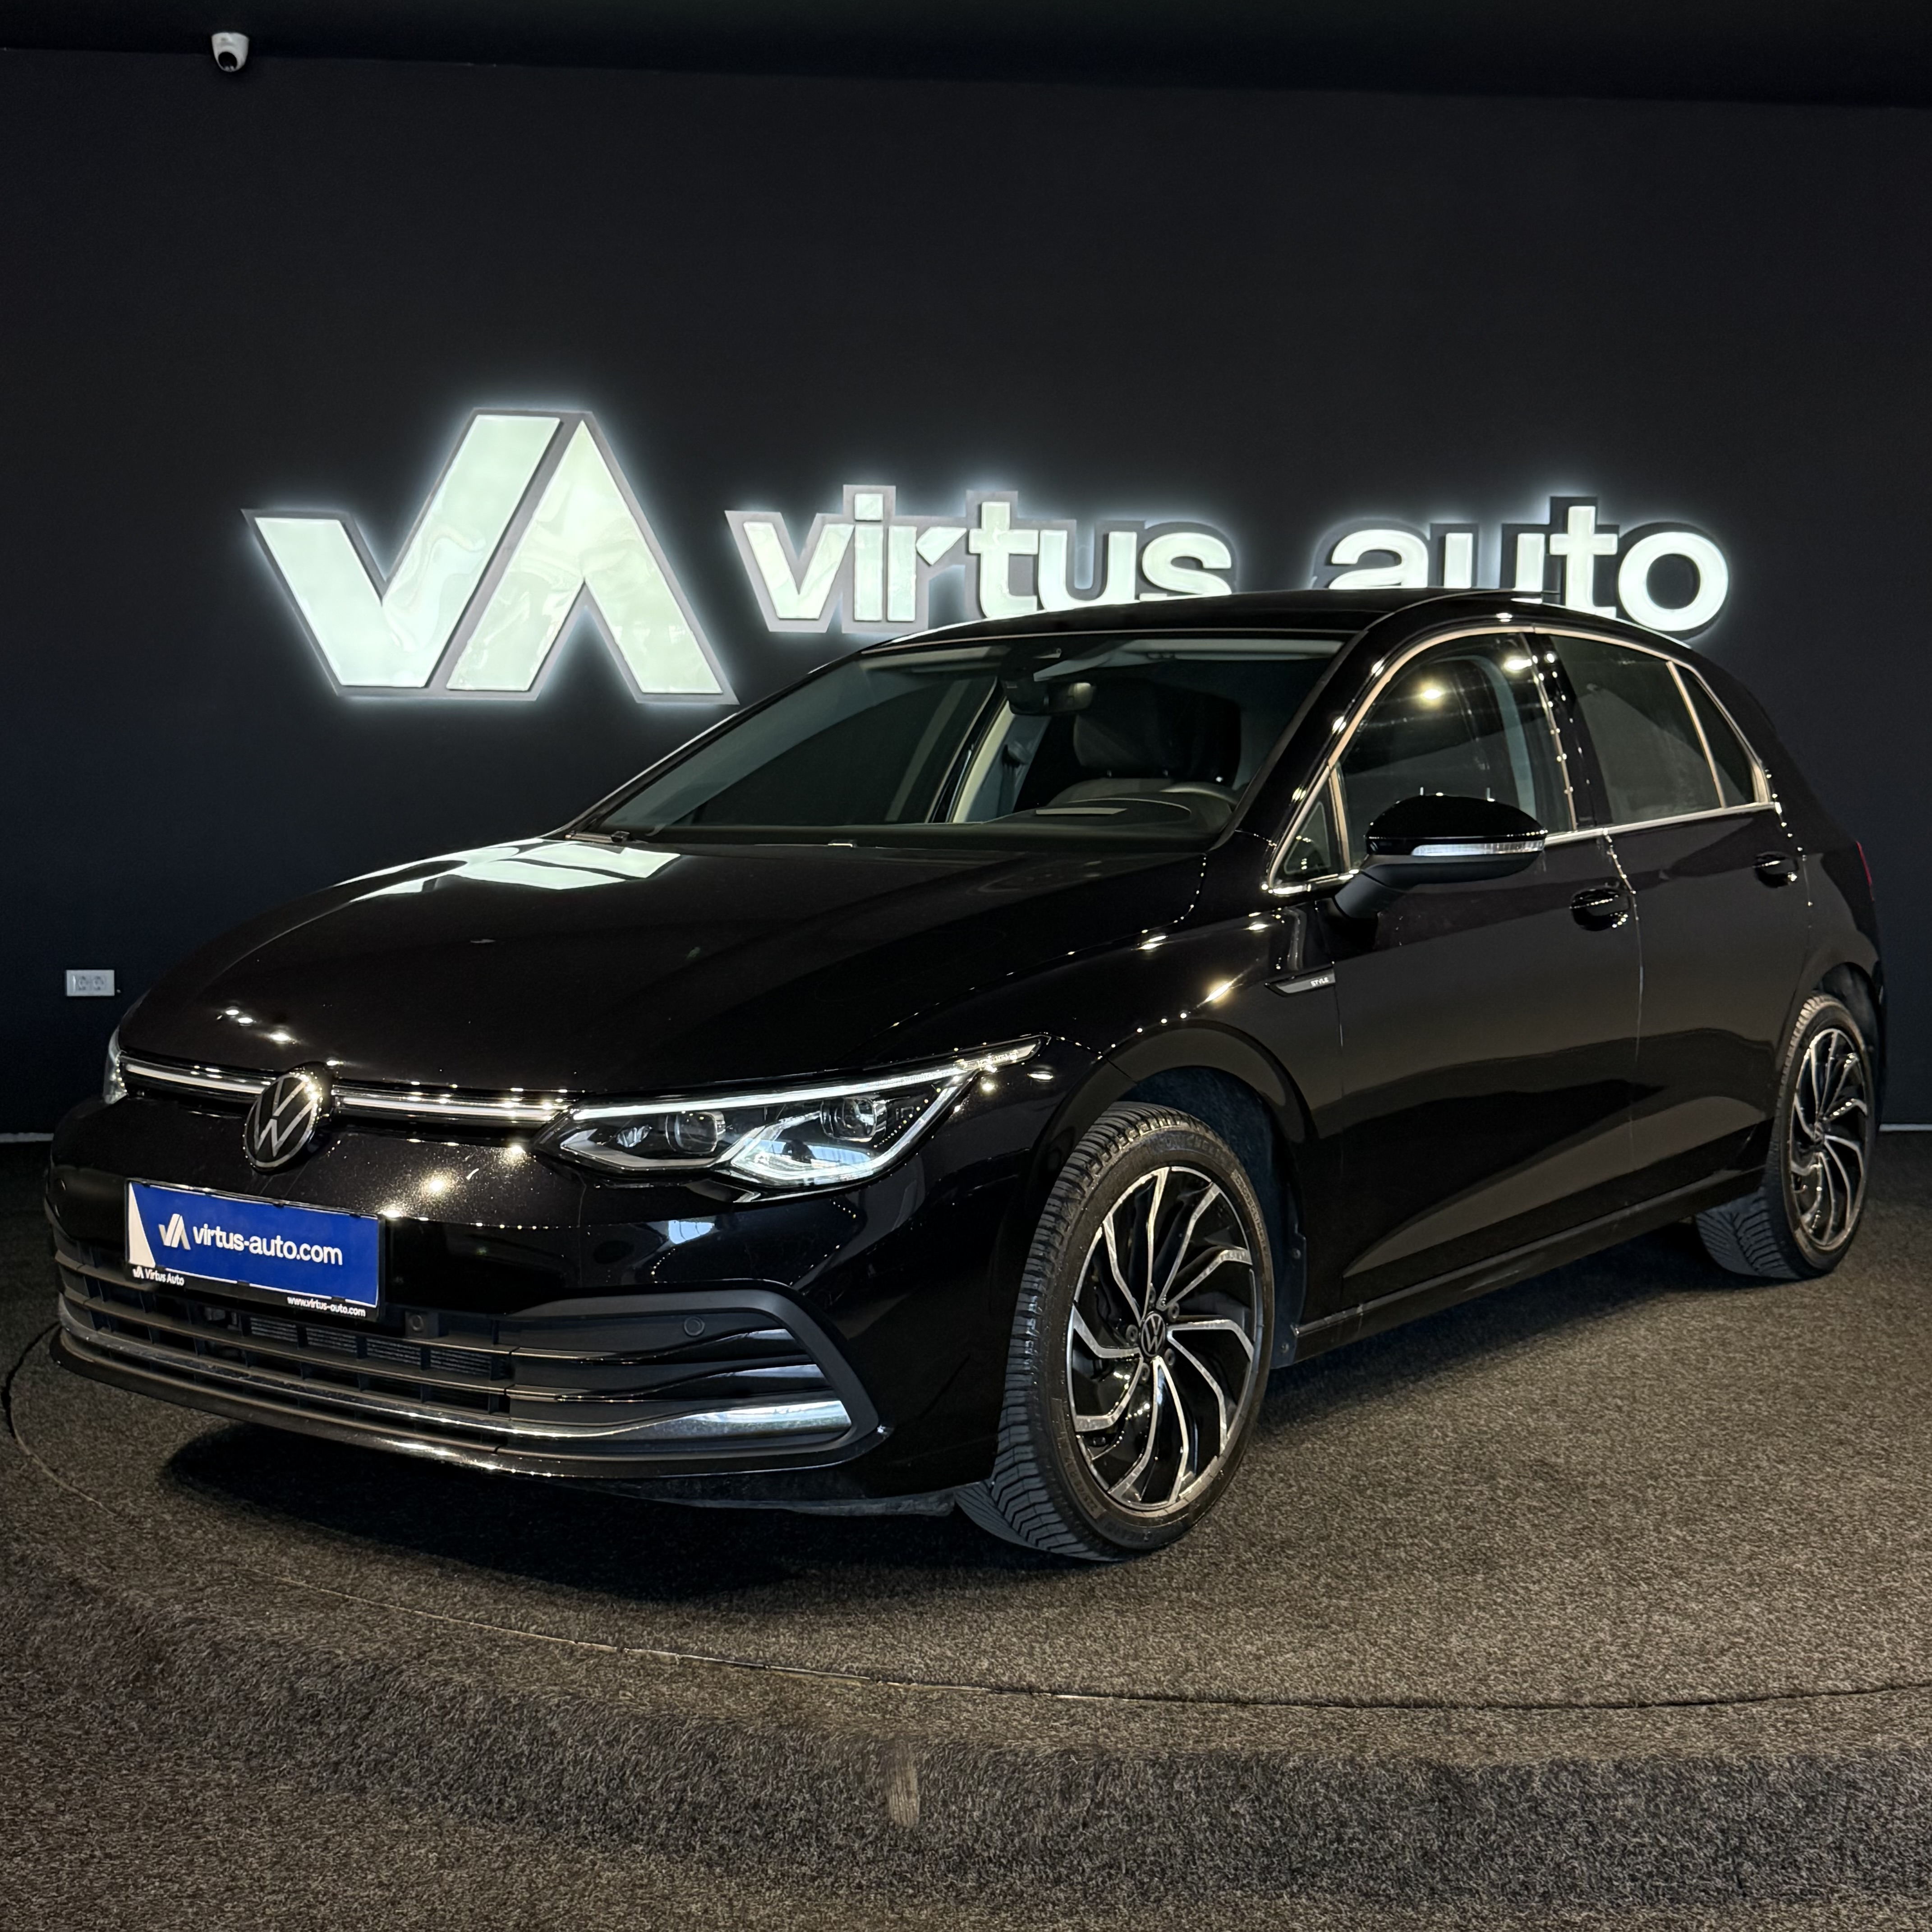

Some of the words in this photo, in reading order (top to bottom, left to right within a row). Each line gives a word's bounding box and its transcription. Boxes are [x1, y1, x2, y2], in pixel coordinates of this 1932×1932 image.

[743, 492, 1233, 622] virtus
[193, 1223, 343, 1265] virtus-auto.com
[144, 1268, 166, 1283] Virtus
[166, 1273, 184, 1286] Auto
[287, 1296, 366, 1317] www.virtus-auto.com
